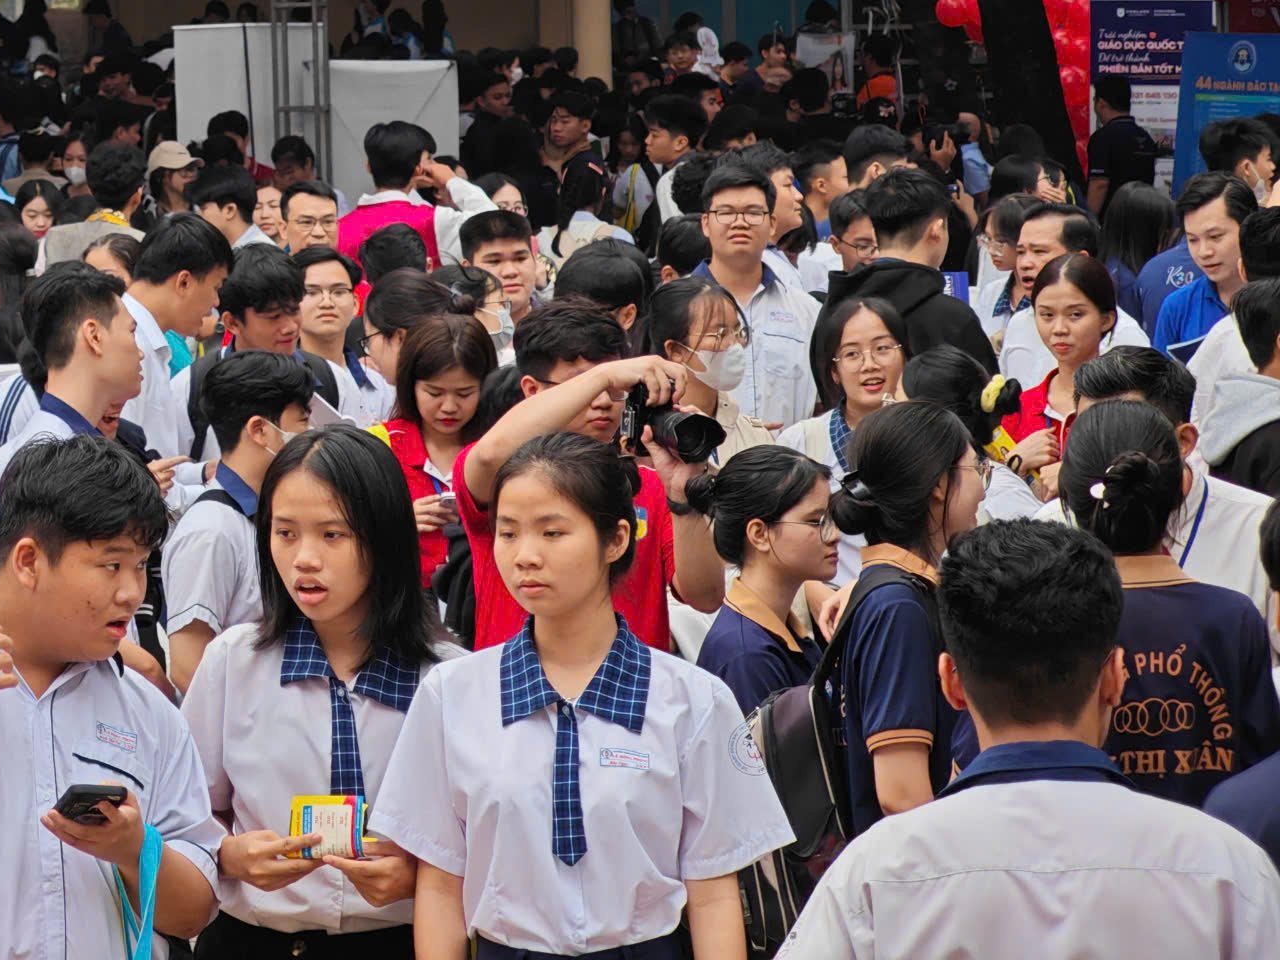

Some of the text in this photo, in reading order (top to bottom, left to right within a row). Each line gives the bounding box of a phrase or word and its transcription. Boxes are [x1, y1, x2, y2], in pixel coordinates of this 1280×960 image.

[1133, 643, 1233, 740] PHỔ THÔNG
[1121, 740, 1235, 779] THỊ XÂN
